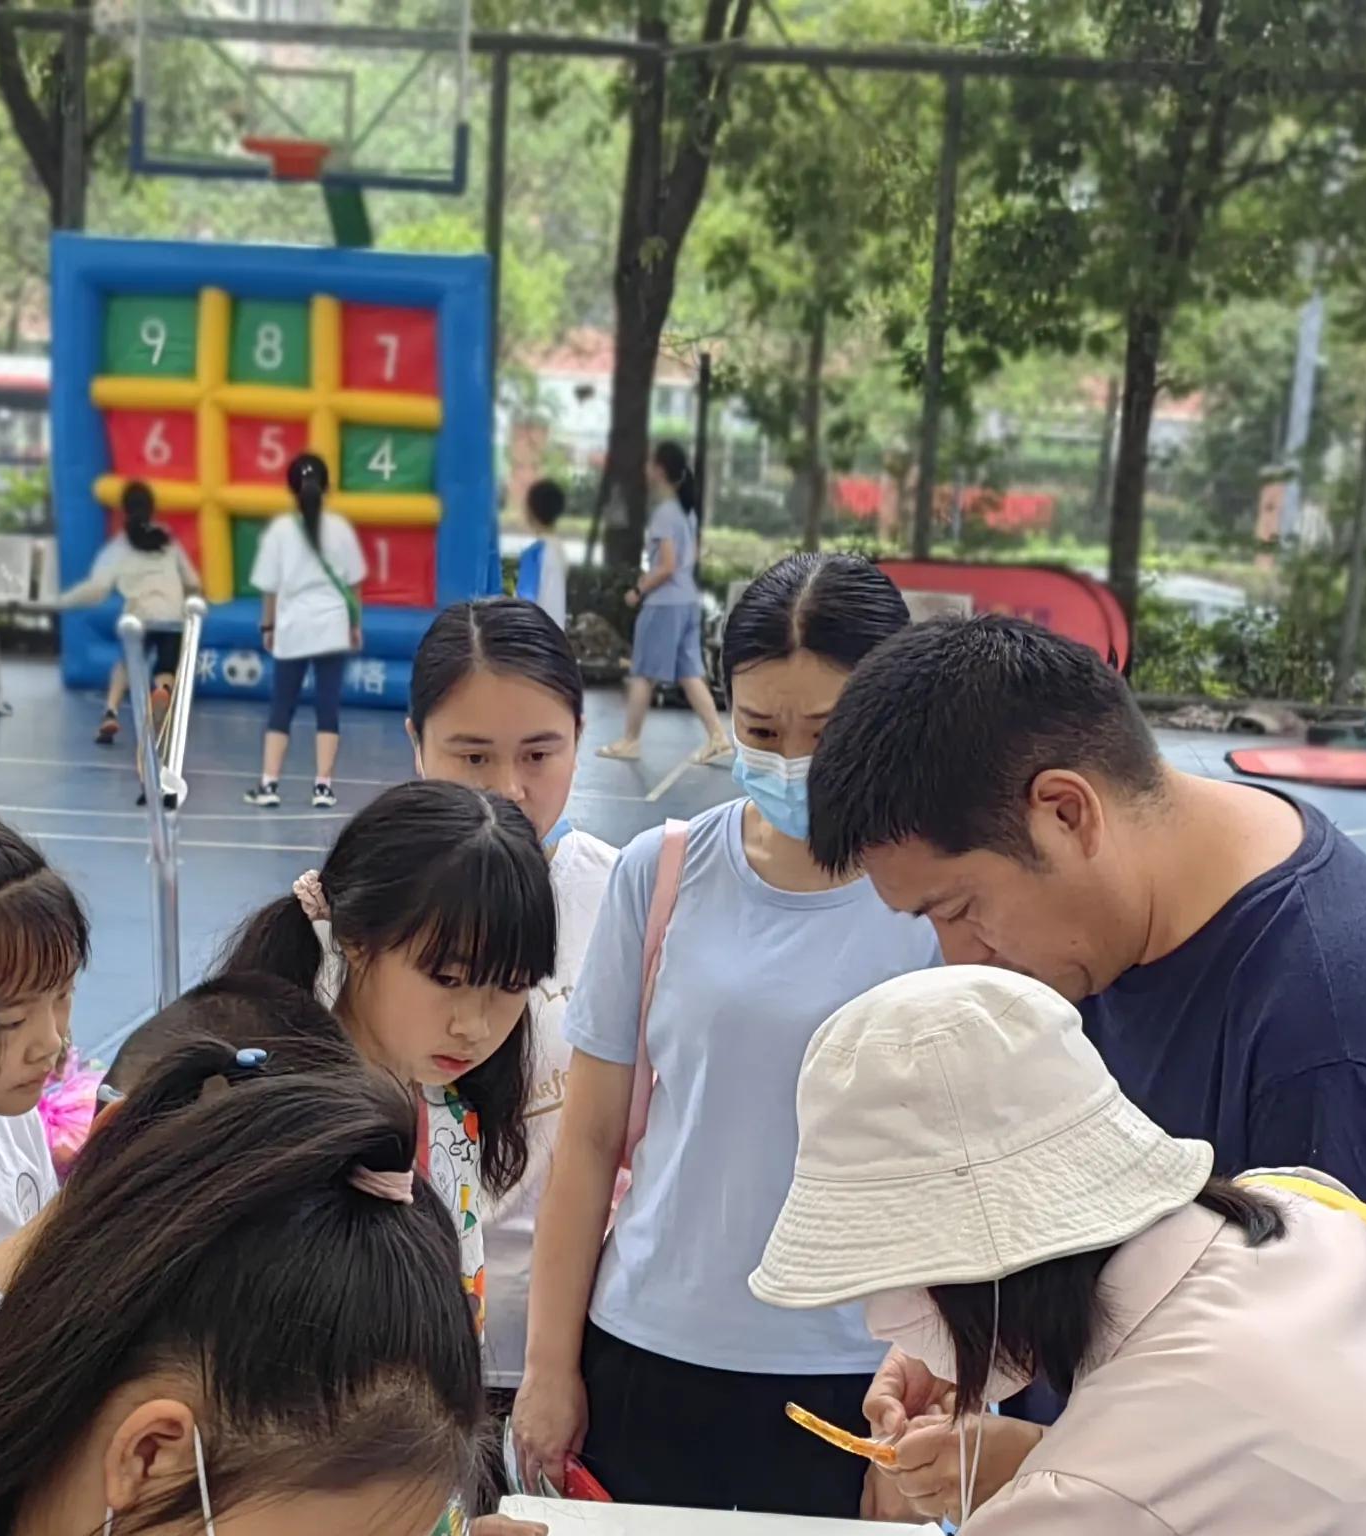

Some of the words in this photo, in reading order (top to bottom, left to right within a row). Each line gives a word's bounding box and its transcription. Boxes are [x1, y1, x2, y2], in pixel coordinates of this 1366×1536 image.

[142, 318, 167, 366] 9
[254, 323, 284, 370] 8
[376, 333, 401, 382] 7
[143, 420, 172, 465] 6
[256, 426, 287, 472] 5
[367, 438, 398, 482] 4
[375, 541, 390, 582] 1
